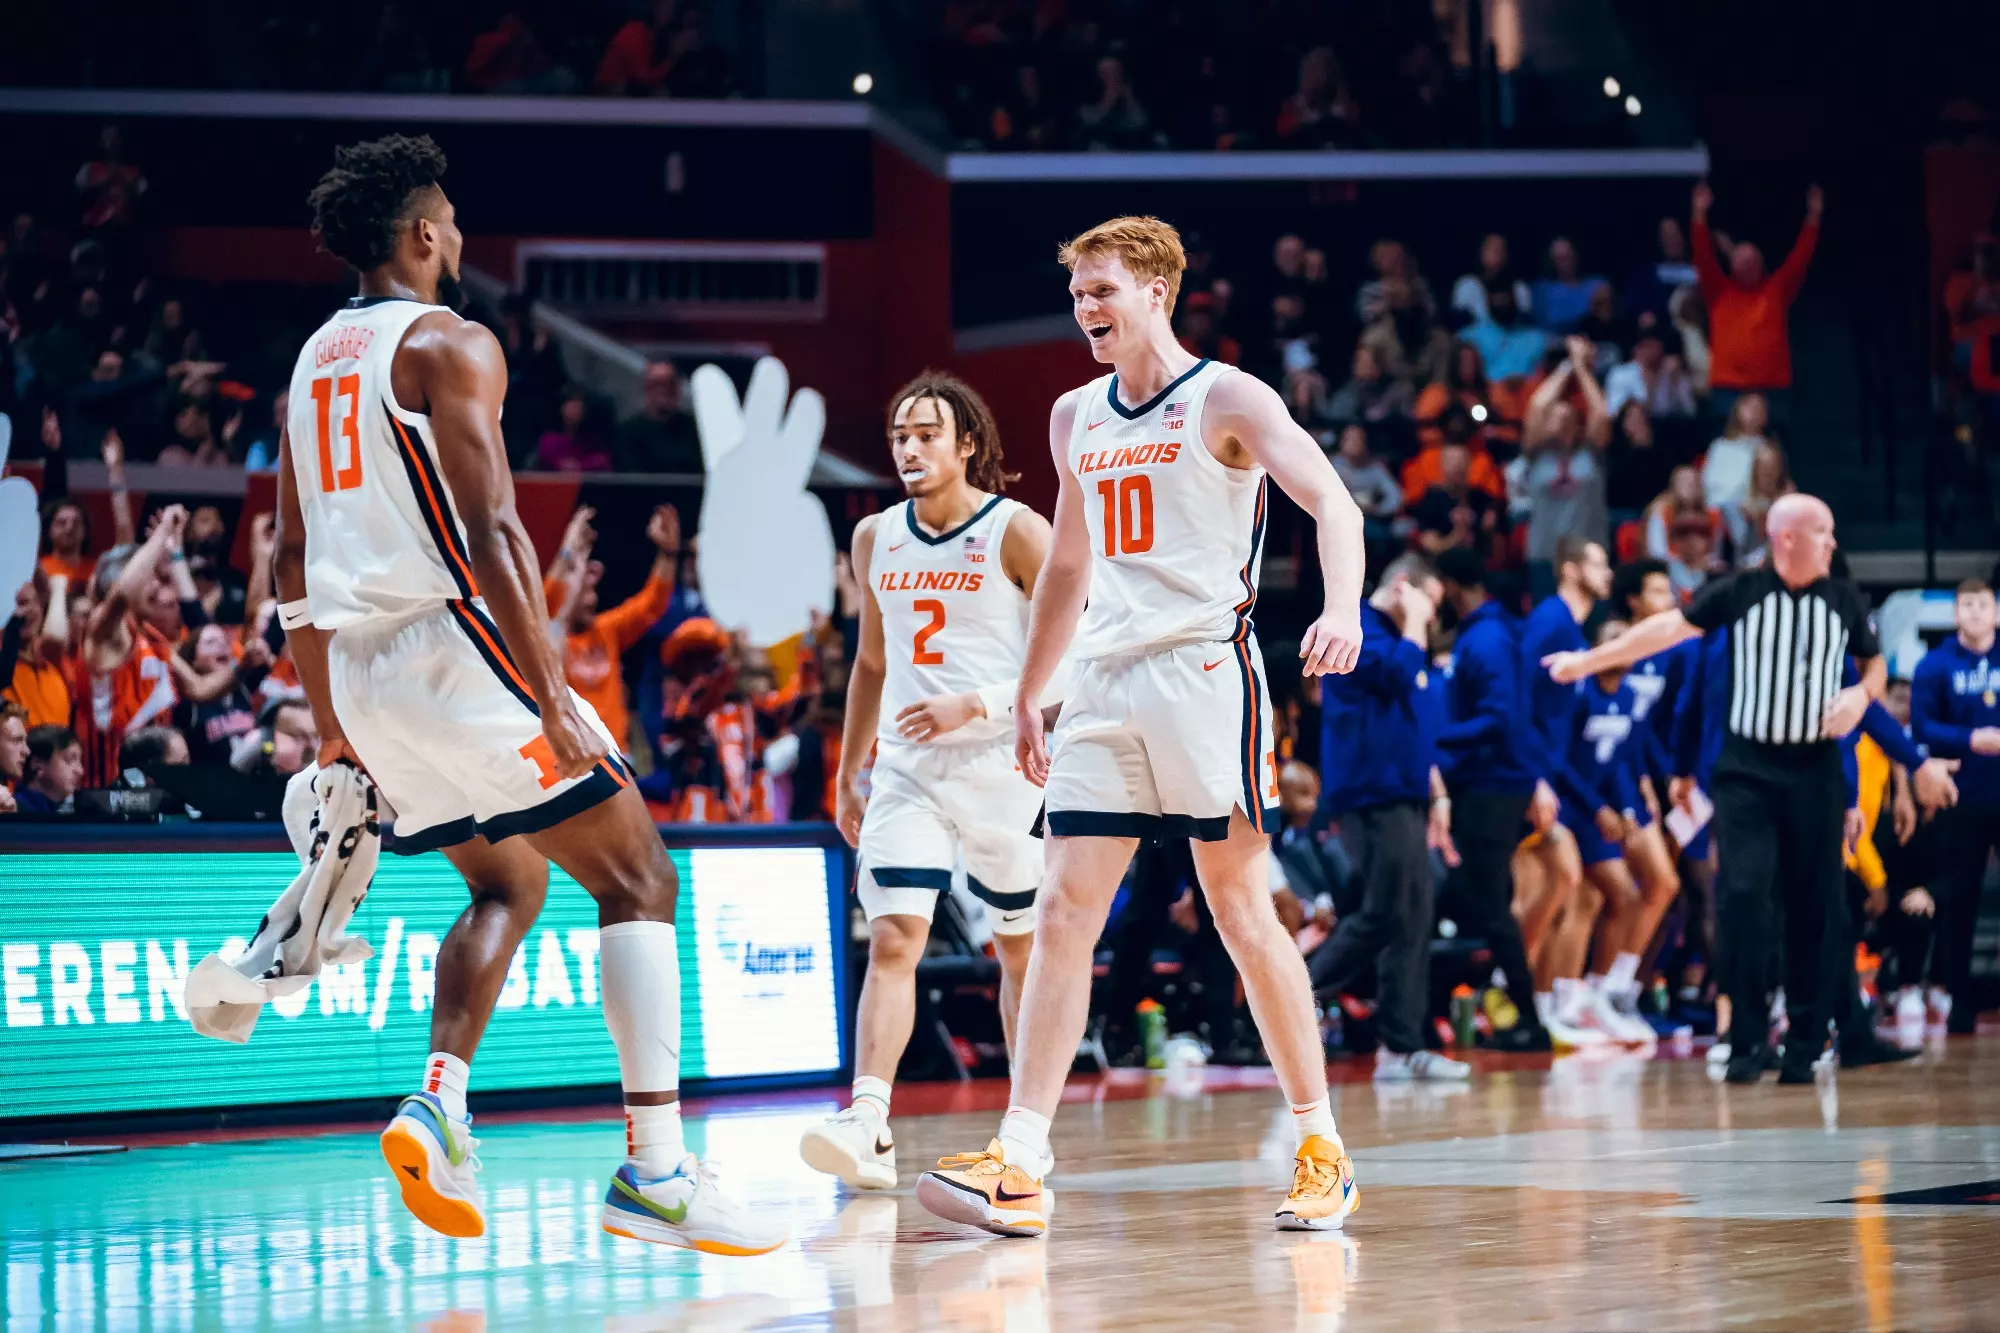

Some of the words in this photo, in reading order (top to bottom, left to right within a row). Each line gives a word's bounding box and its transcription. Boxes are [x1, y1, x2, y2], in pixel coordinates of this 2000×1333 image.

[311, 373, 363, 493] 13
[1079, 442, 1182, 475] ILLINOIS
[1097, 474, 1155, 557] 10
[879, 571, 985, 592] ILLINOIS
[912, 598, 946, 665] 2
